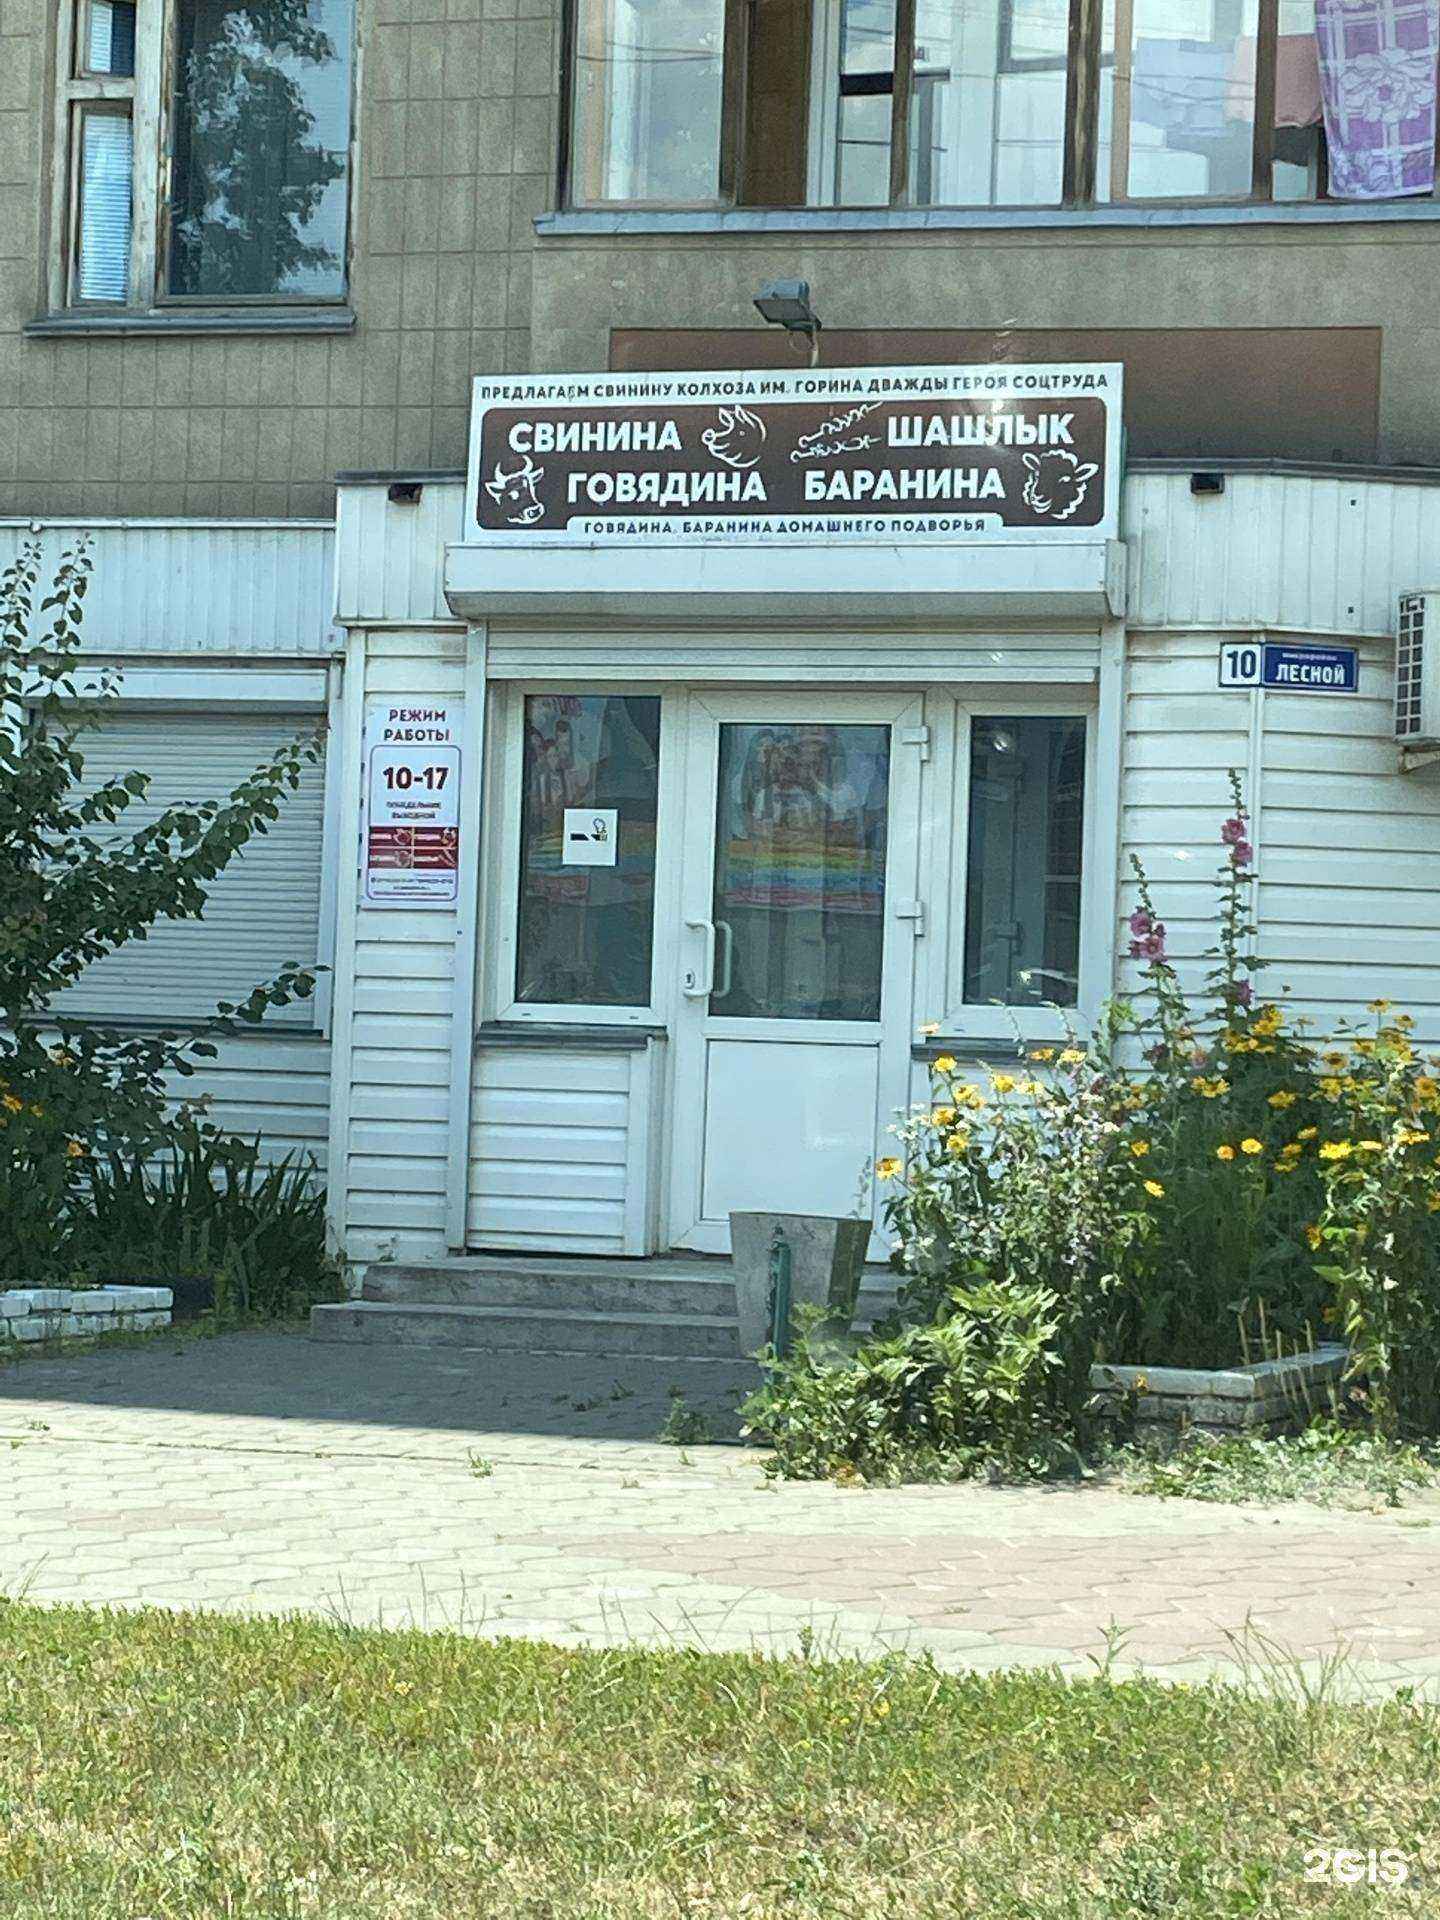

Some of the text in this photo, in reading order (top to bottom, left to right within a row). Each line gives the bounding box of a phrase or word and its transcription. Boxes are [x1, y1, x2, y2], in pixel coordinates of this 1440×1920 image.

[593, 382, 673, 398] СВИНИНУ
[677, 381, 756, 396] КОЛХОЗА
[794, 379, 863, 393] ГОРИНА
[867, 378, 948, 393] ДВАЖДЫ
[952, 376, 1008, 390] ГЕРОЯ
[1012, 373, 1109, 389] СОЦТРУДА
[507, 420, 682, 453] СВИНИНА
[887, 412, 1075, 447] ШАШЛЫК
[567, 472, 768, 507] ГОВЯДИНА
[804, 468, 1006, 501] БАРАНИНА
[683, 520, 772, 533] БАРАНИНА
[776, 519, 886, 533] ДОМАШНЕГО
[891, 519, 985, 532] ПОДВОРЬЯ
[1227, 650, 1256, 679] 10
[1276, 664, 1345, 685] ЛЕСНОЙ
[389, 709, 446, 722] РЕЖИМ
[384, 729, 450, 741] РАБОТЫ
[383, 767, 449, 790] 10-17
